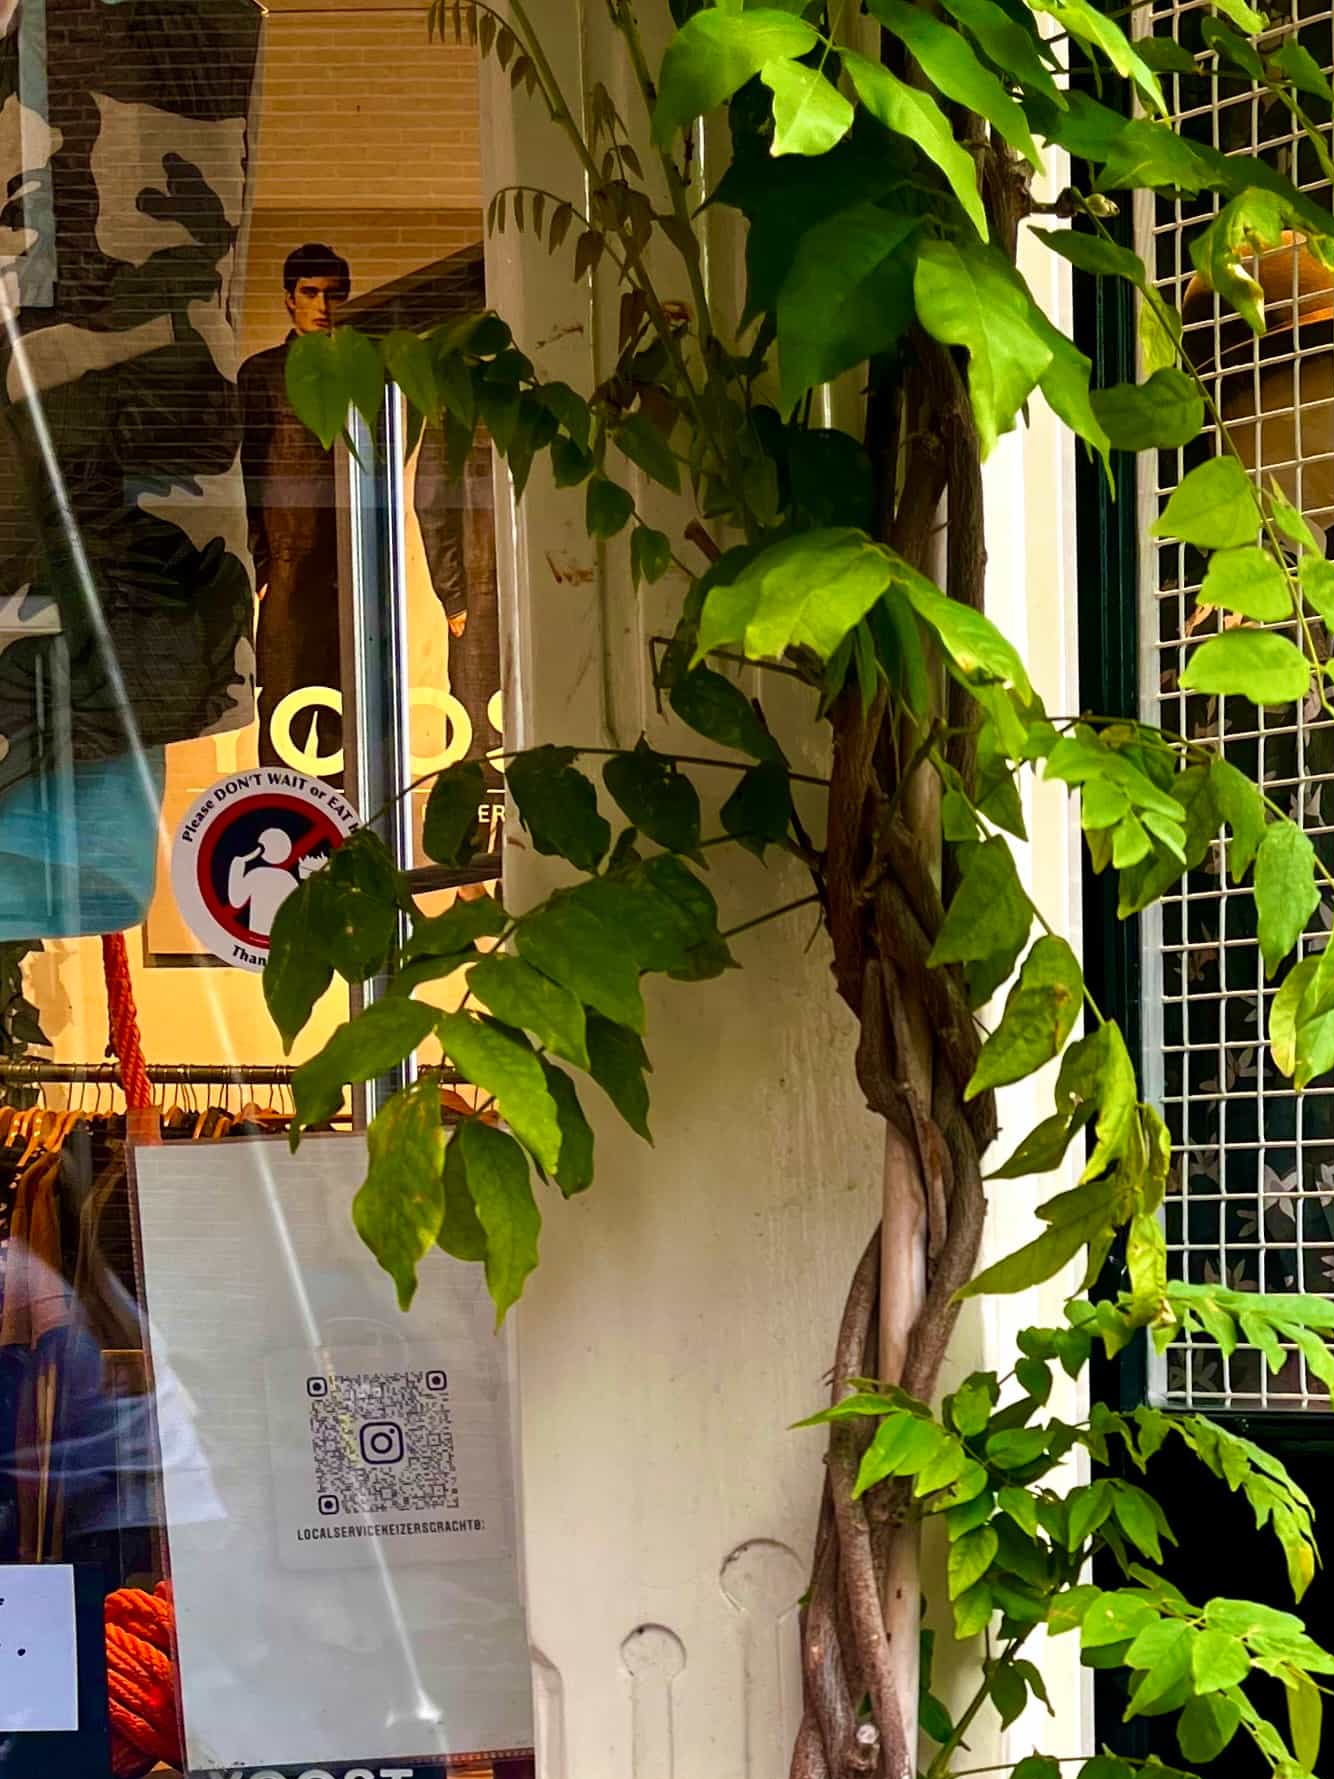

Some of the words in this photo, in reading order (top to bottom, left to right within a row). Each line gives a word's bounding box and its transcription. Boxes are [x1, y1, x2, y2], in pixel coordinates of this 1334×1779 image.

[181, 798, 216, 843] Please
[214, 773, 264, 802] DON'T
[267, 773, 308, 791] WAIT
[310, 785, 328, 800] or
[327, 795, 354, 822] EAT
[231, 945, 267, 967] Than
